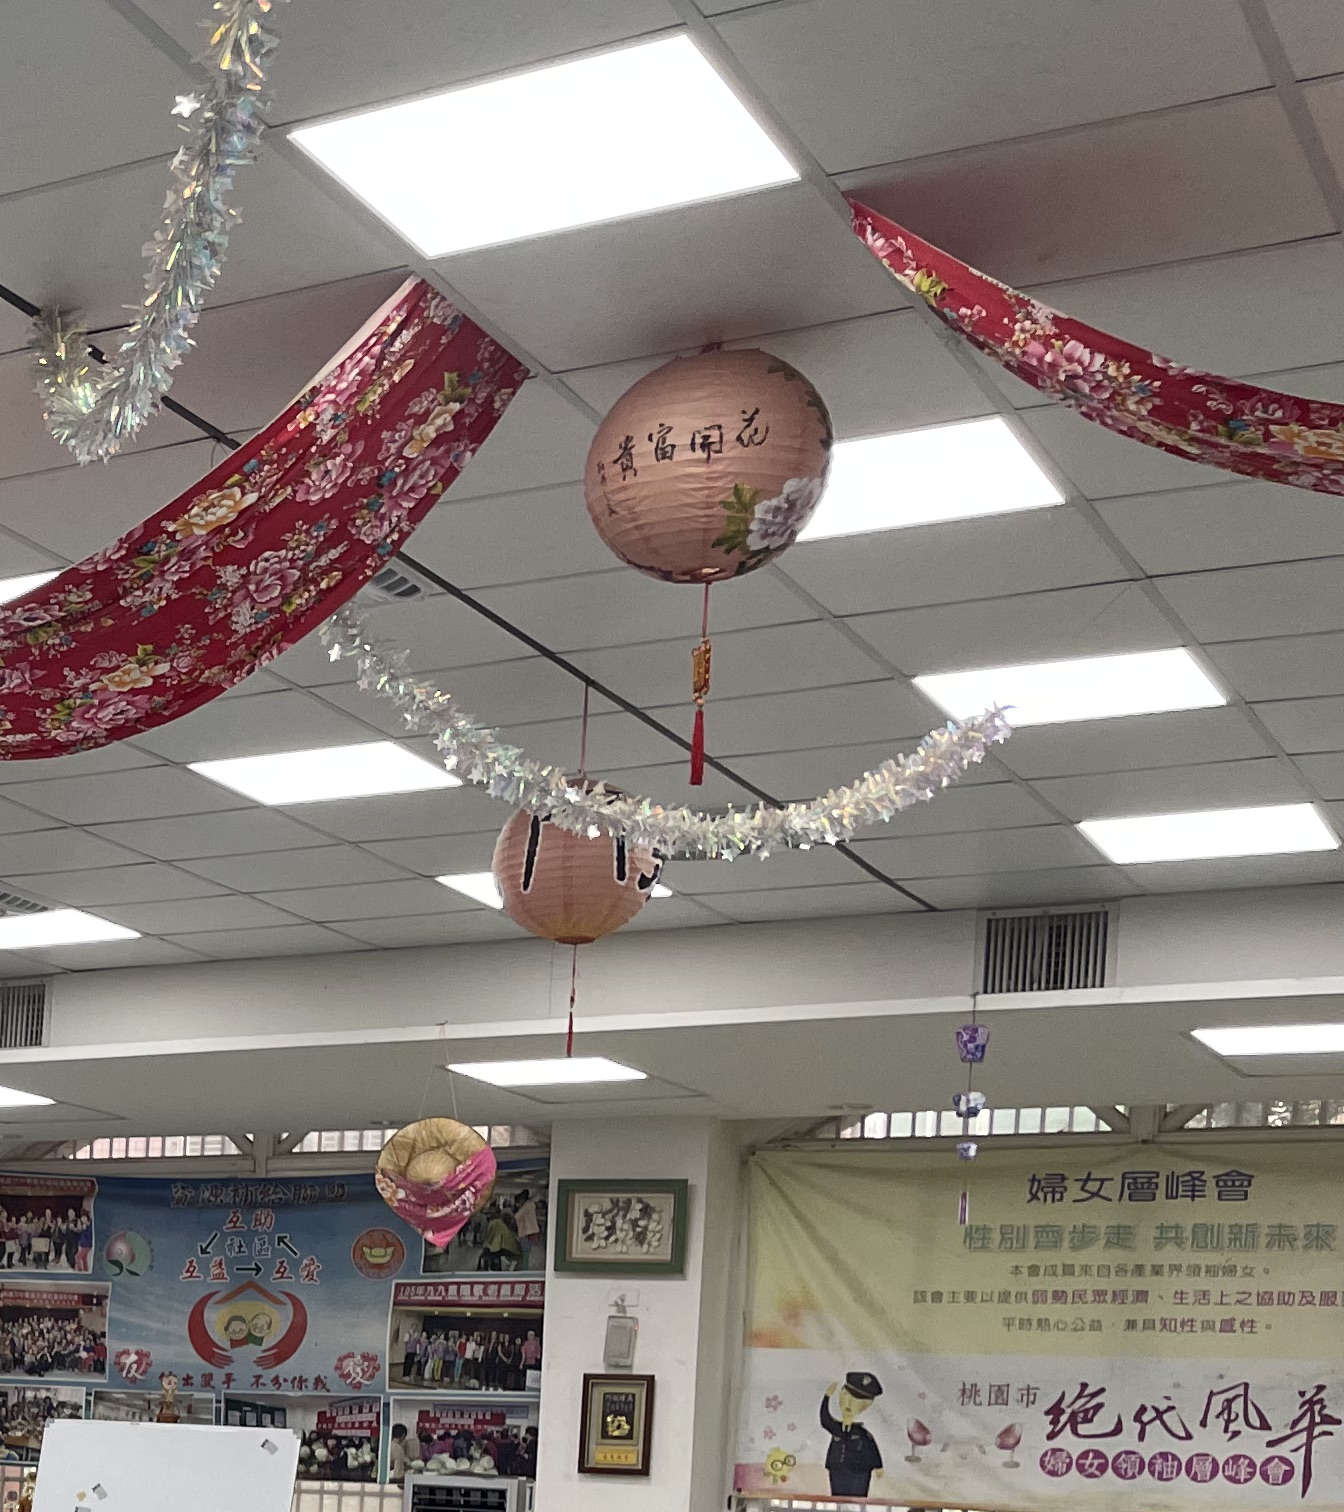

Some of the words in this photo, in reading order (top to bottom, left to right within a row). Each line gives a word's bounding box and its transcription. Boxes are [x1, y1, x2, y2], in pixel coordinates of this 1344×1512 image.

[1026, 1169, 1255, 1205] 婦女層峰會
[223, 1208, 276, 1232] 互助
[225, 1235, 272, 1258] 社區
[963, 1222, 1136, 1252] 性別齊步走
[1153, 1221, 1339, 1252] 共創新未來
[180, 1256, 230, 1283] 互益
[959, 1381, 1040, 1408] 桃園市
[1042, 1449, 1292, 1485] 婦女領袖層峰會
